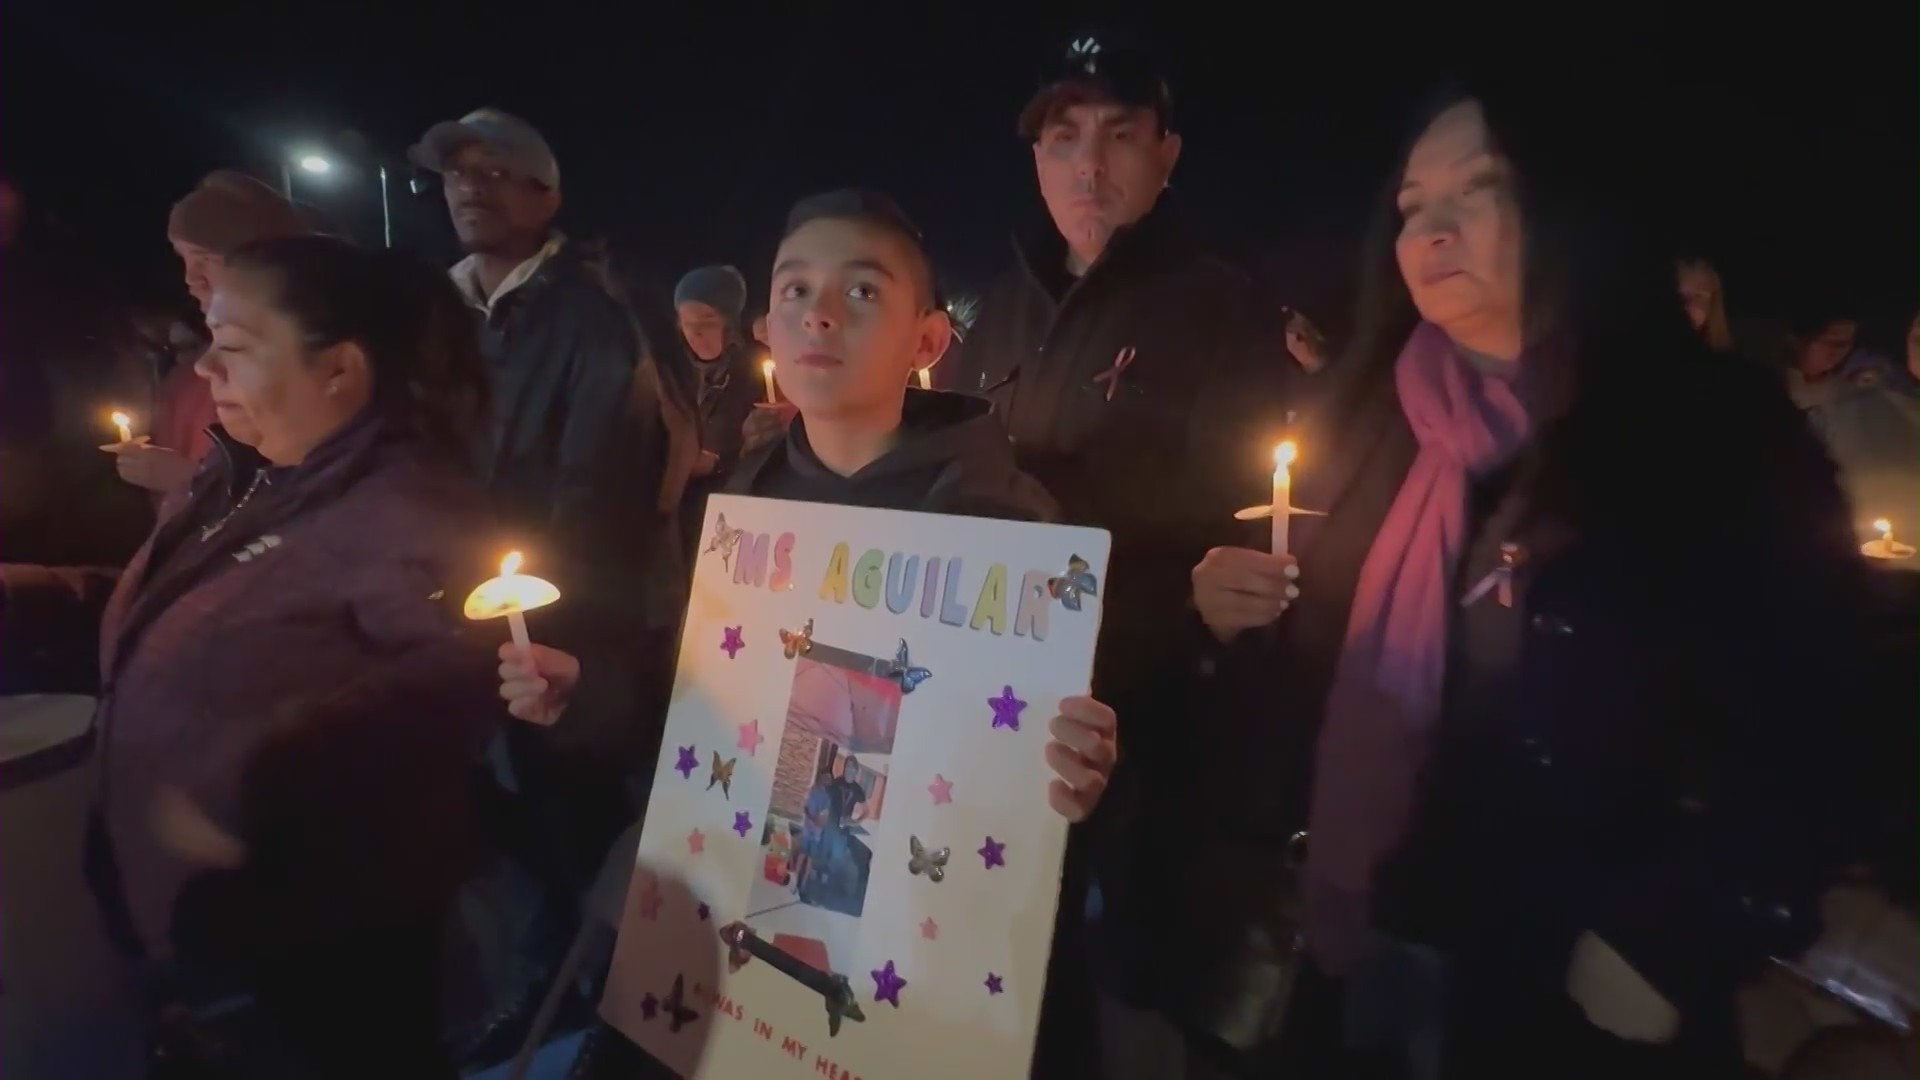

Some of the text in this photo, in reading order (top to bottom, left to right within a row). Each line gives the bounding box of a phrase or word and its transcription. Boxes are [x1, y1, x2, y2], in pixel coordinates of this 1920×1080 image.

[818, 541, 1052, 641] AGUILAR
[753, 1018, 773, 1040] IN
[781, 1036, 807, 1060] MY
[815, 1055, 863, 1080] HEA
